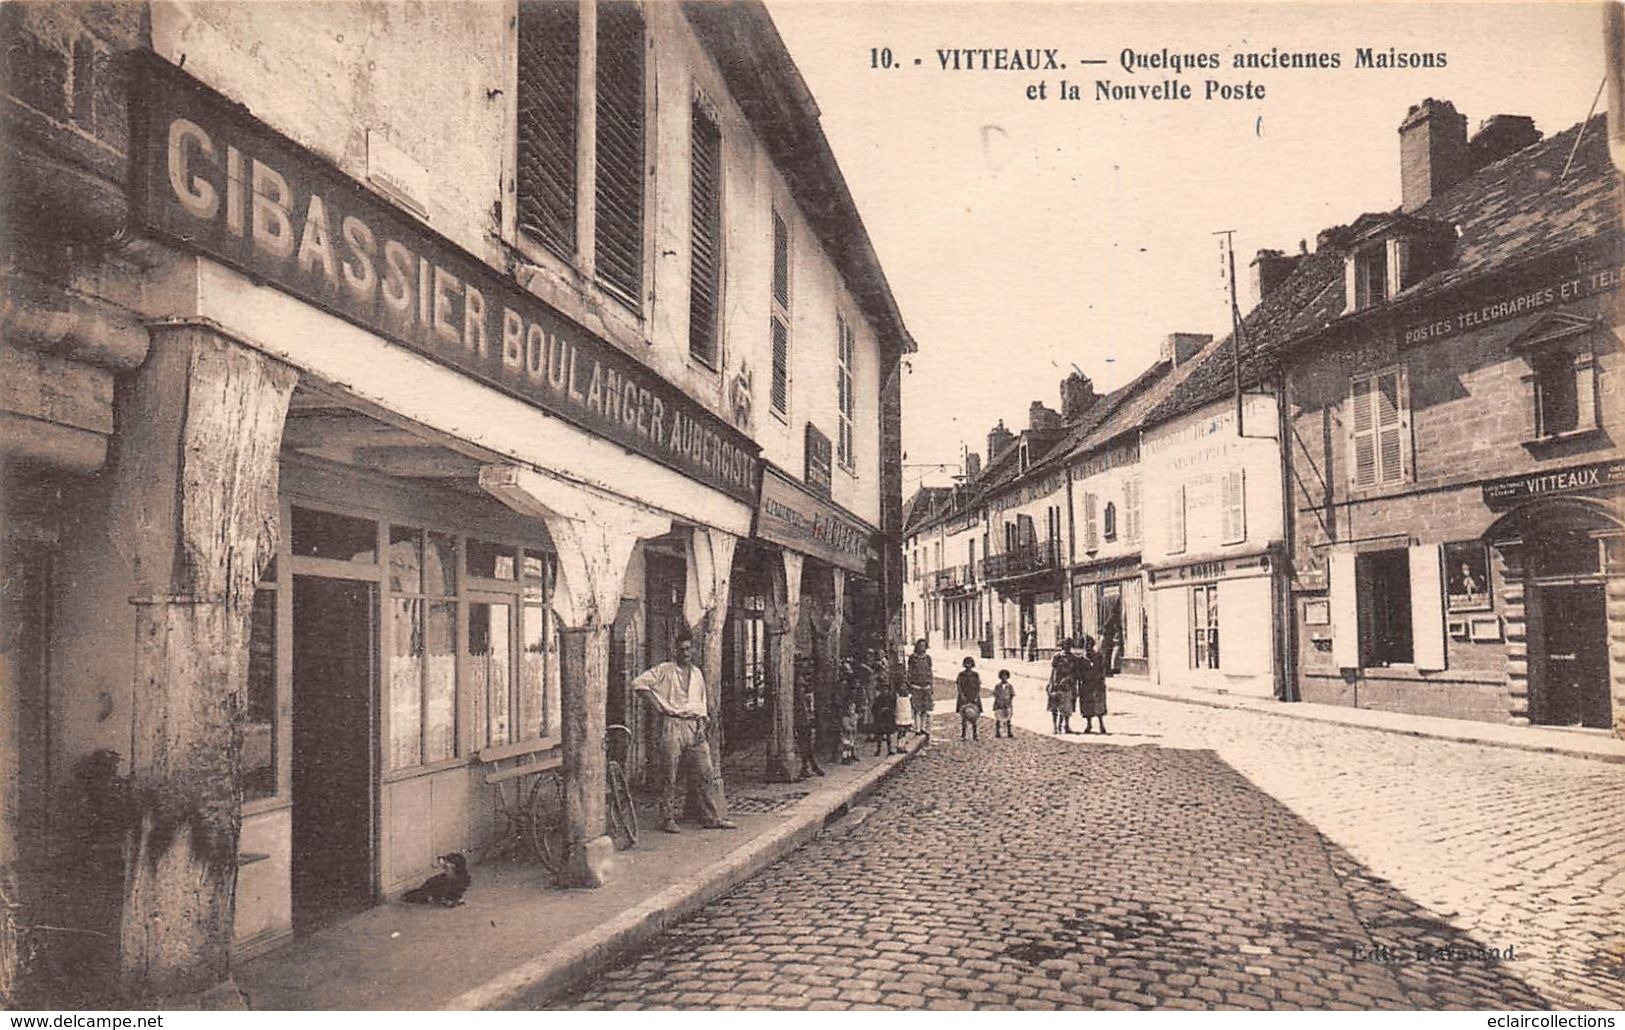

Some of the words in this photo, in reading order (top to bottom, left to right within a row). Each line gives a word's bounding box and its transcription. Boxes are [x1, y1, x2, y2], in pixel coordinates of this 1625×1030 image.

[167, 118, 489, 359] GIBASSIER
[502, 306, 664, 445] BOULANGER
[670, 411, 756, 489] AUBERGISTE
[1405, 319, 1452, 344] POSTES
[1560, 279, 1581, 300] ET
[1526, 468, 1601, 494] VITTEAUX
